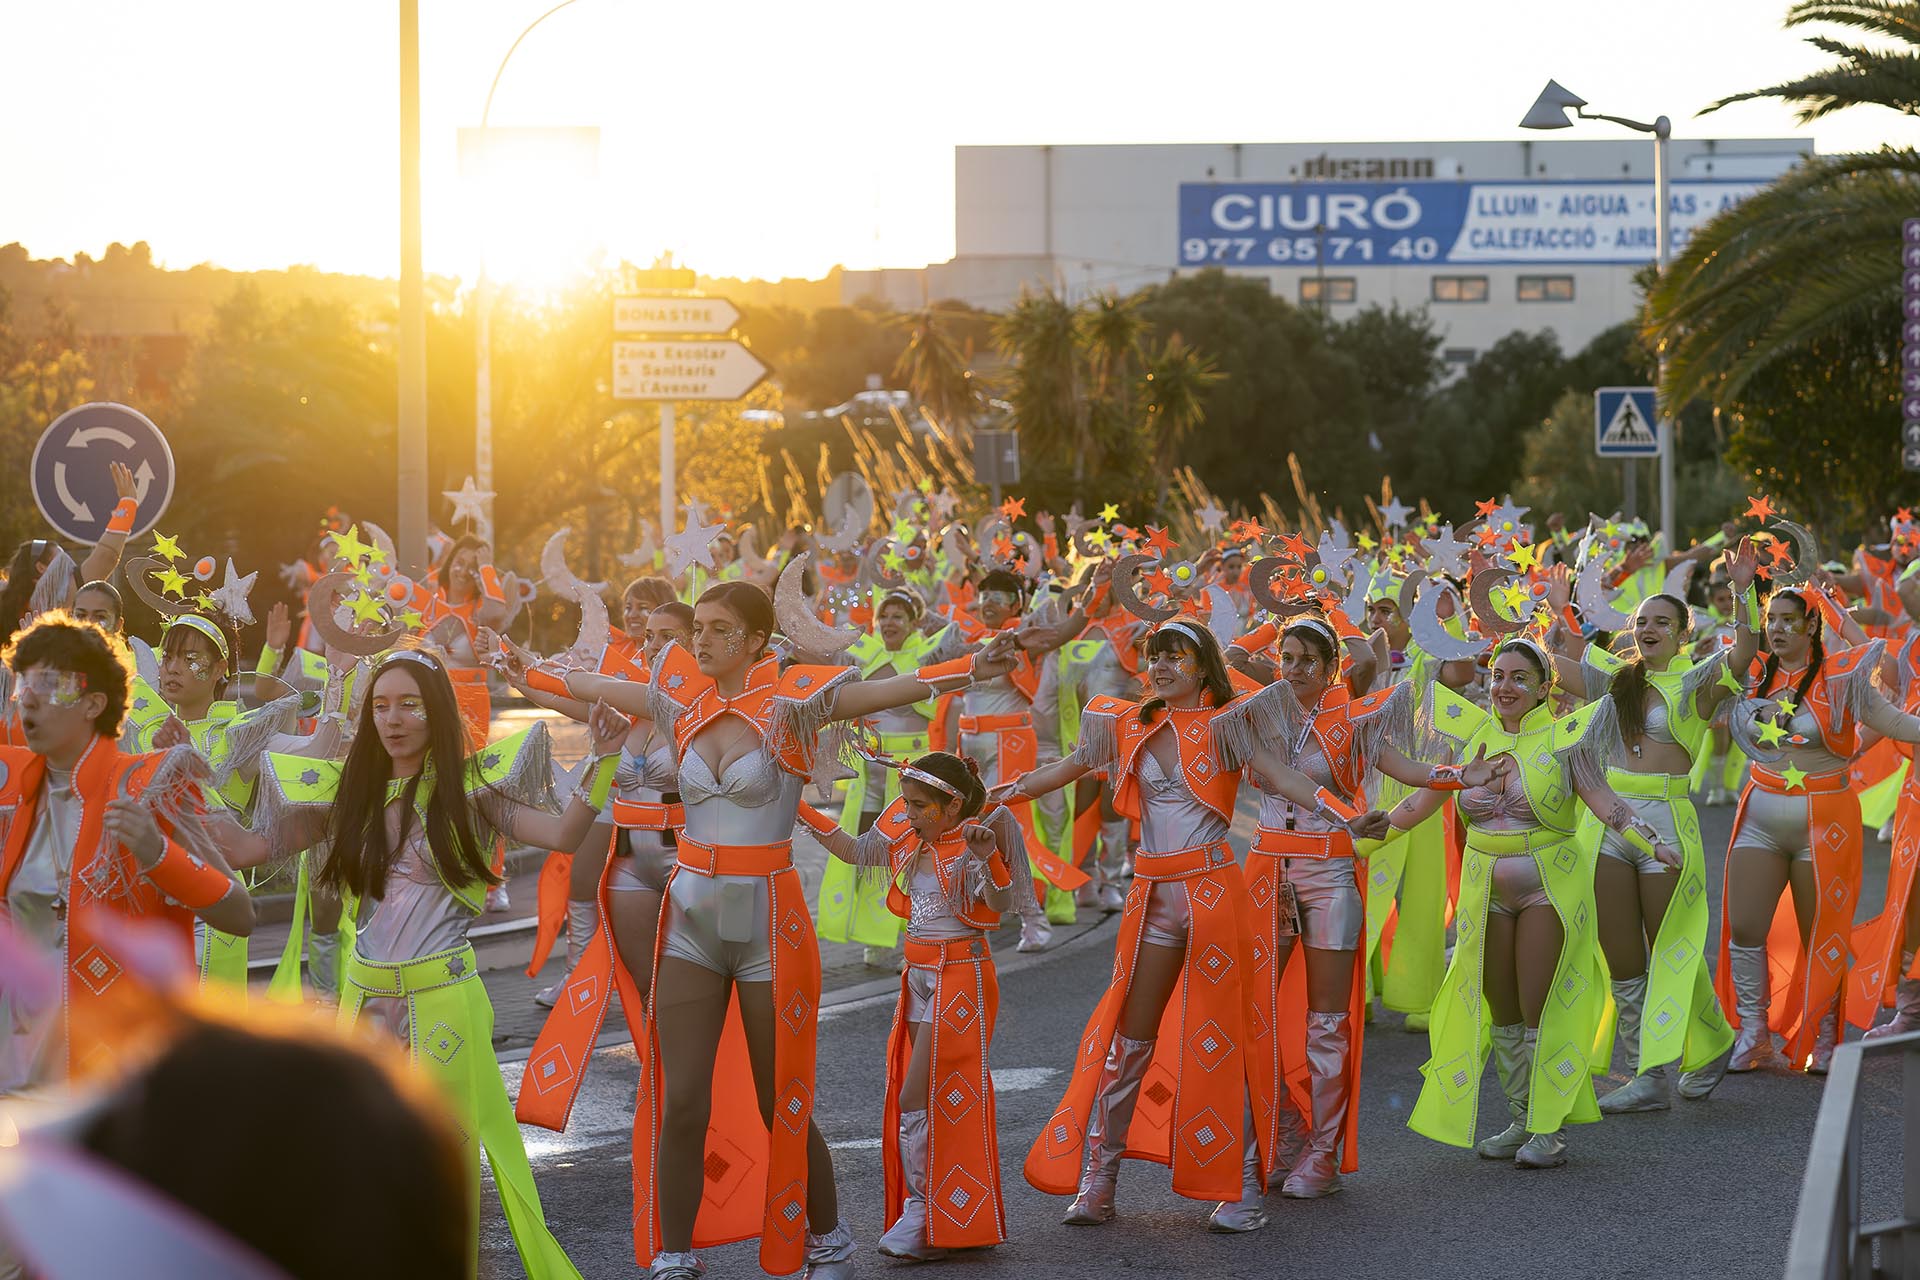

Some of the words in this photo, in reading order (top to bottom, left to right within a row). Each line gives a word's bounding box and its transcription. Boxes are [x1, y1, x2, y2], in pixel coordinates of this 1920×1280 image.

[1211, 187, 1422, 231] CIURÓ
[1477, 194, 1538, 216] LLUM
[1558, 194, 1629, 216] AIGUA
[1469, 223, 1597, 249] CALEFACCIÓ
[1183, 237, 1257, 261] 977
[1267, 236, 1318, 261] 65
[1328, 236, 1374, 260] 71
[1387, 236, 1439, 260] 40
[618, 308, 712, 322] BONASTRE
[618, 346, 657, 360] Zona
[664, 346, 727, 360] Escolar
